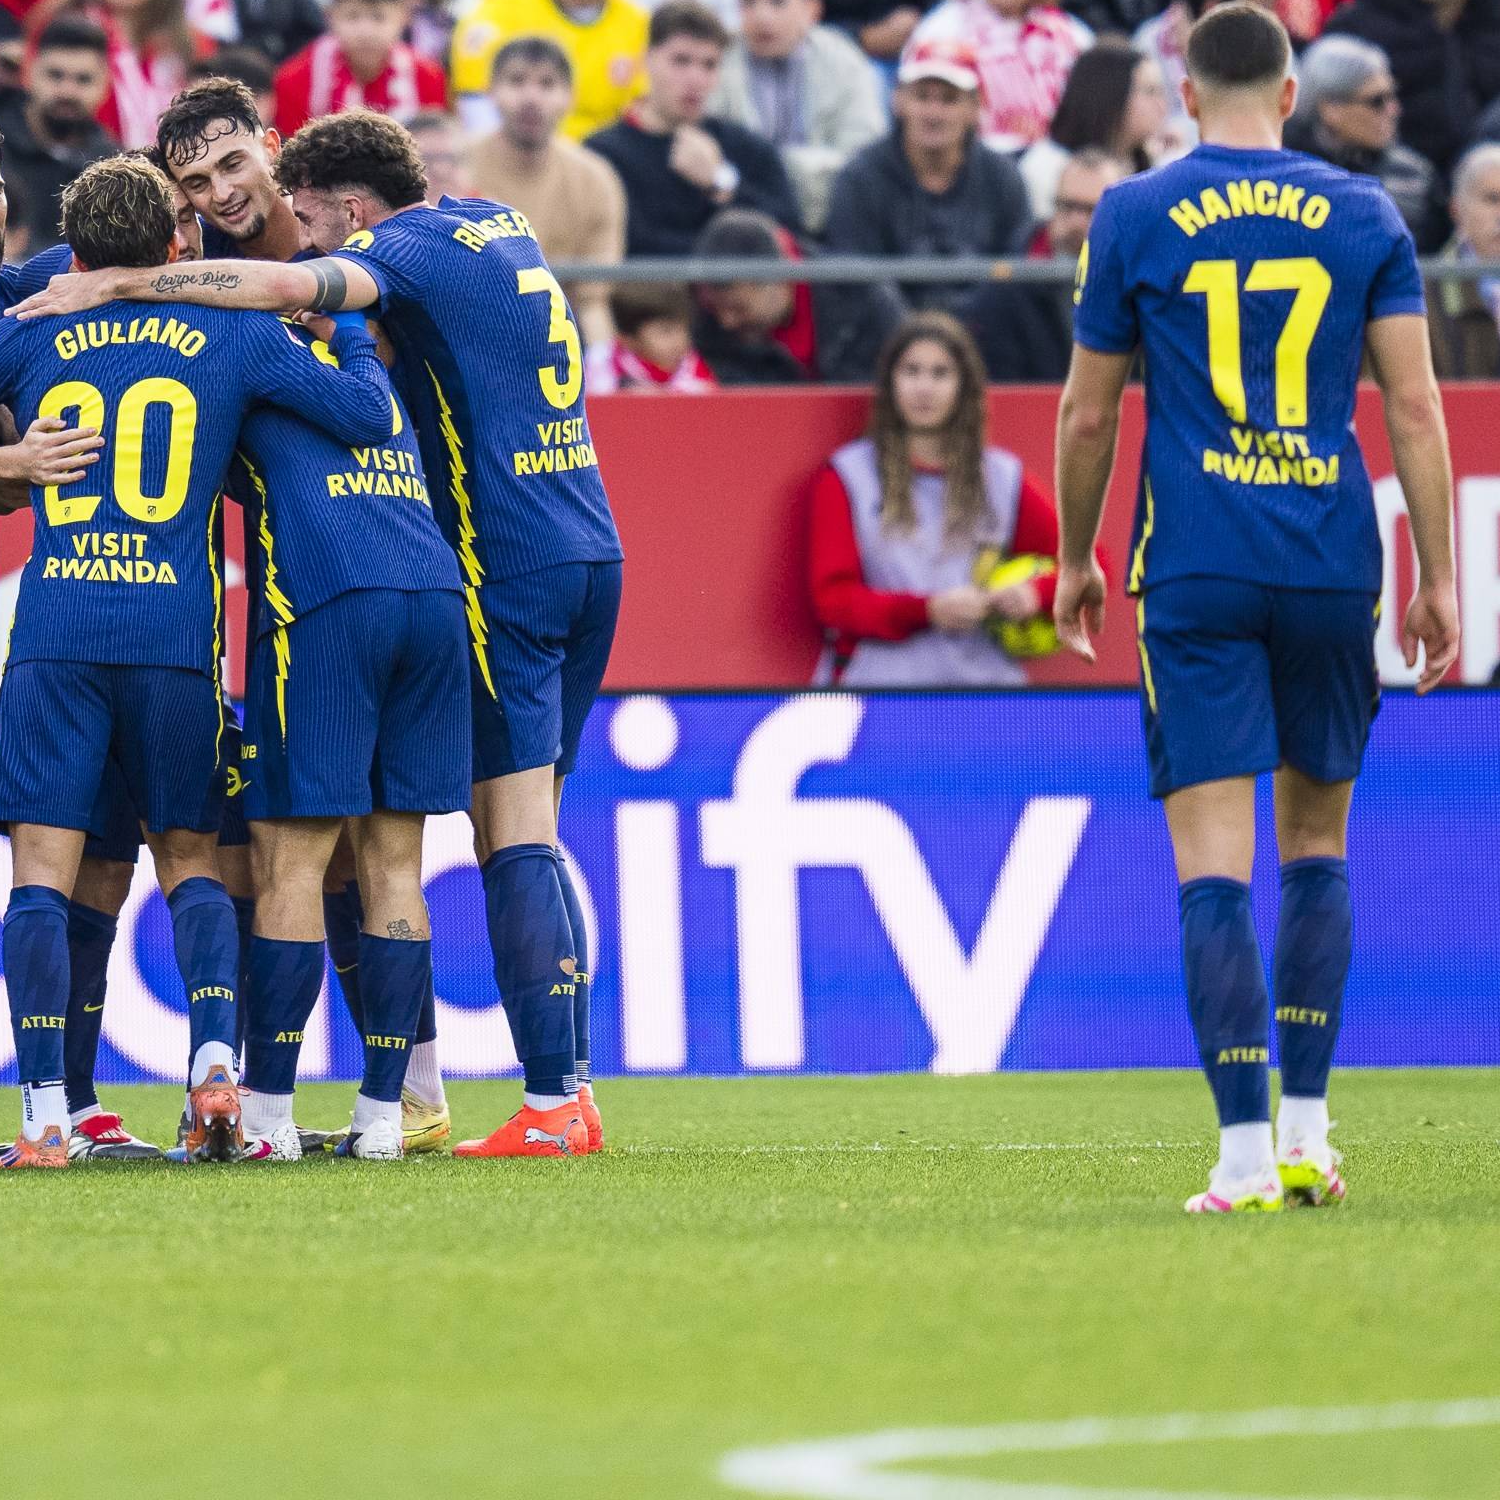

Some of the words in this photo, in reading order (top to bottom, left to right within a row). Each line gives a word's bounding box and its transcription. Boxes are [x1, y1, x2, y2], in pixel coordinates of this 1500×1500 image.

[1168, 180, 1331, 237] HANCKO
[151, 274, 198, 293] Carpe
[198, 270, 242, 290] Diem
[54, 317, 207, 360] GIULIANO
[516, 266, 583, 410] 3
[1182, 256, 1333, 427] 17
[534, 418, 584, 446] VISIT
[1230, 427, 1310, 458] VISIT
[38, 377, 198, 527] 20
[351, 447, 417, 475] VISIT
[1203, 449, 1340, 486] RWANDA
[72, 532, 148, 559] VISIT
[42, 556, 178, 585] RWANDA
[192, 986, 234, 1003] ATLETI
[549, 983, 576, 997] ATL
[365, 1035, 407, 1050] ATLETI
